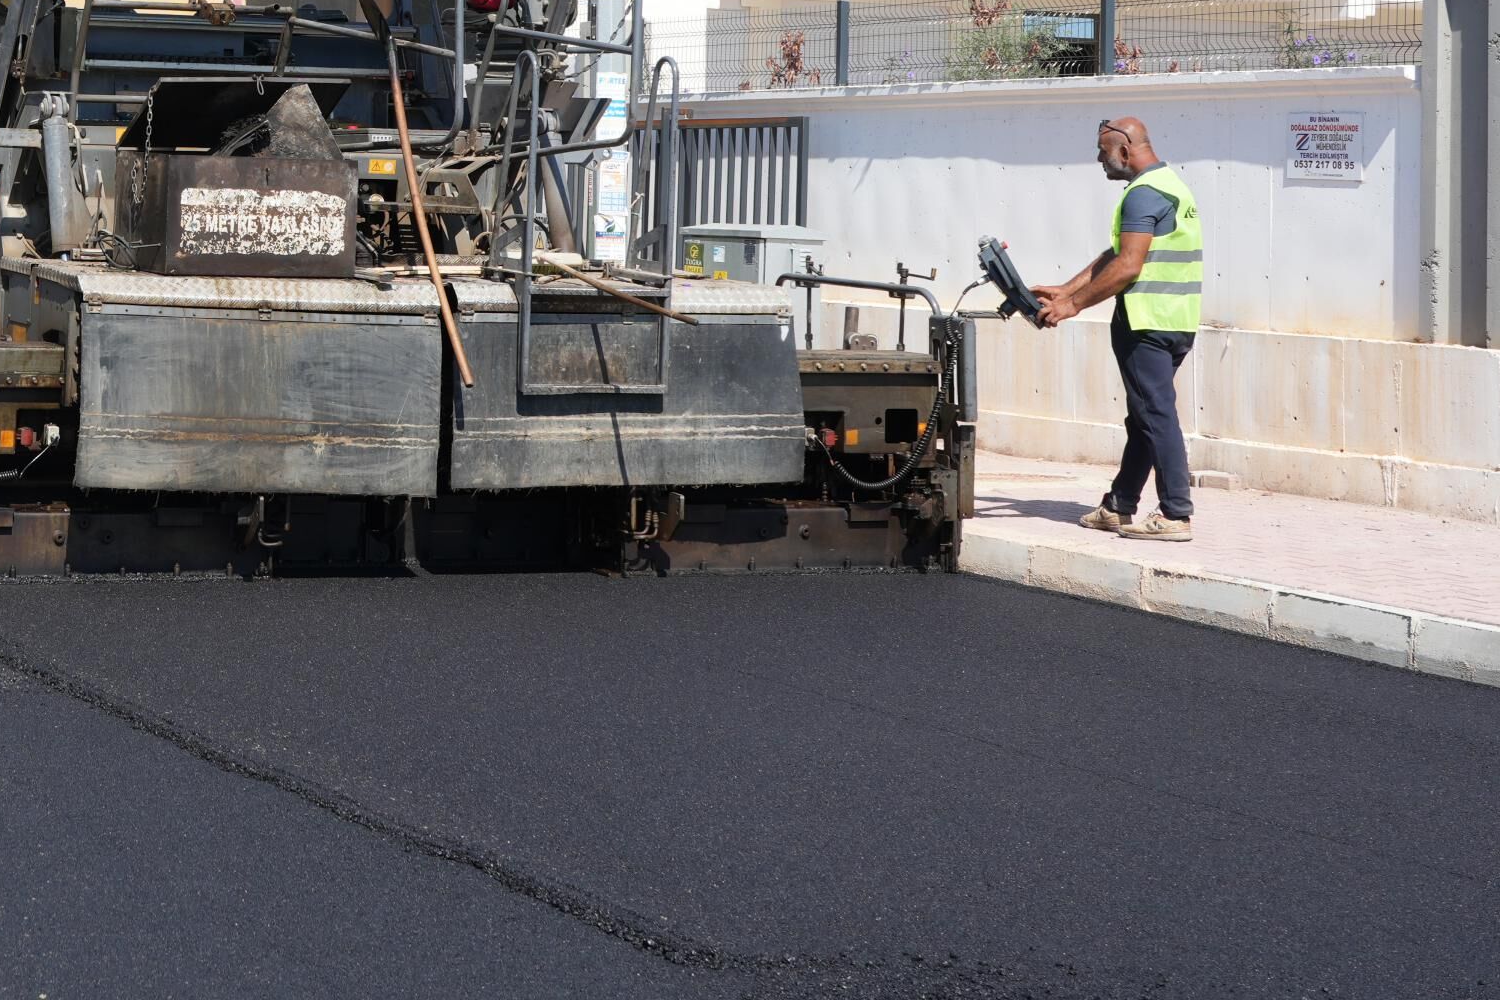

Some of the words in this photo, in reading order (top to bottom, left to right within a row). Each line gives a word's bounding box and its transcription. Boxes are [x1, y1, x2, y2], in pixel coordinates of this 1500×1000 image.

[1329, 133, 1353, 141] DOĞALGAZ
[1316, 142, 1346, 150] MÜHENDİSLİK
[1294, 160, 1313, 168] 0537
[1333, 161, 1342, 169] 08
[205, 213, 258, 234] METRE
